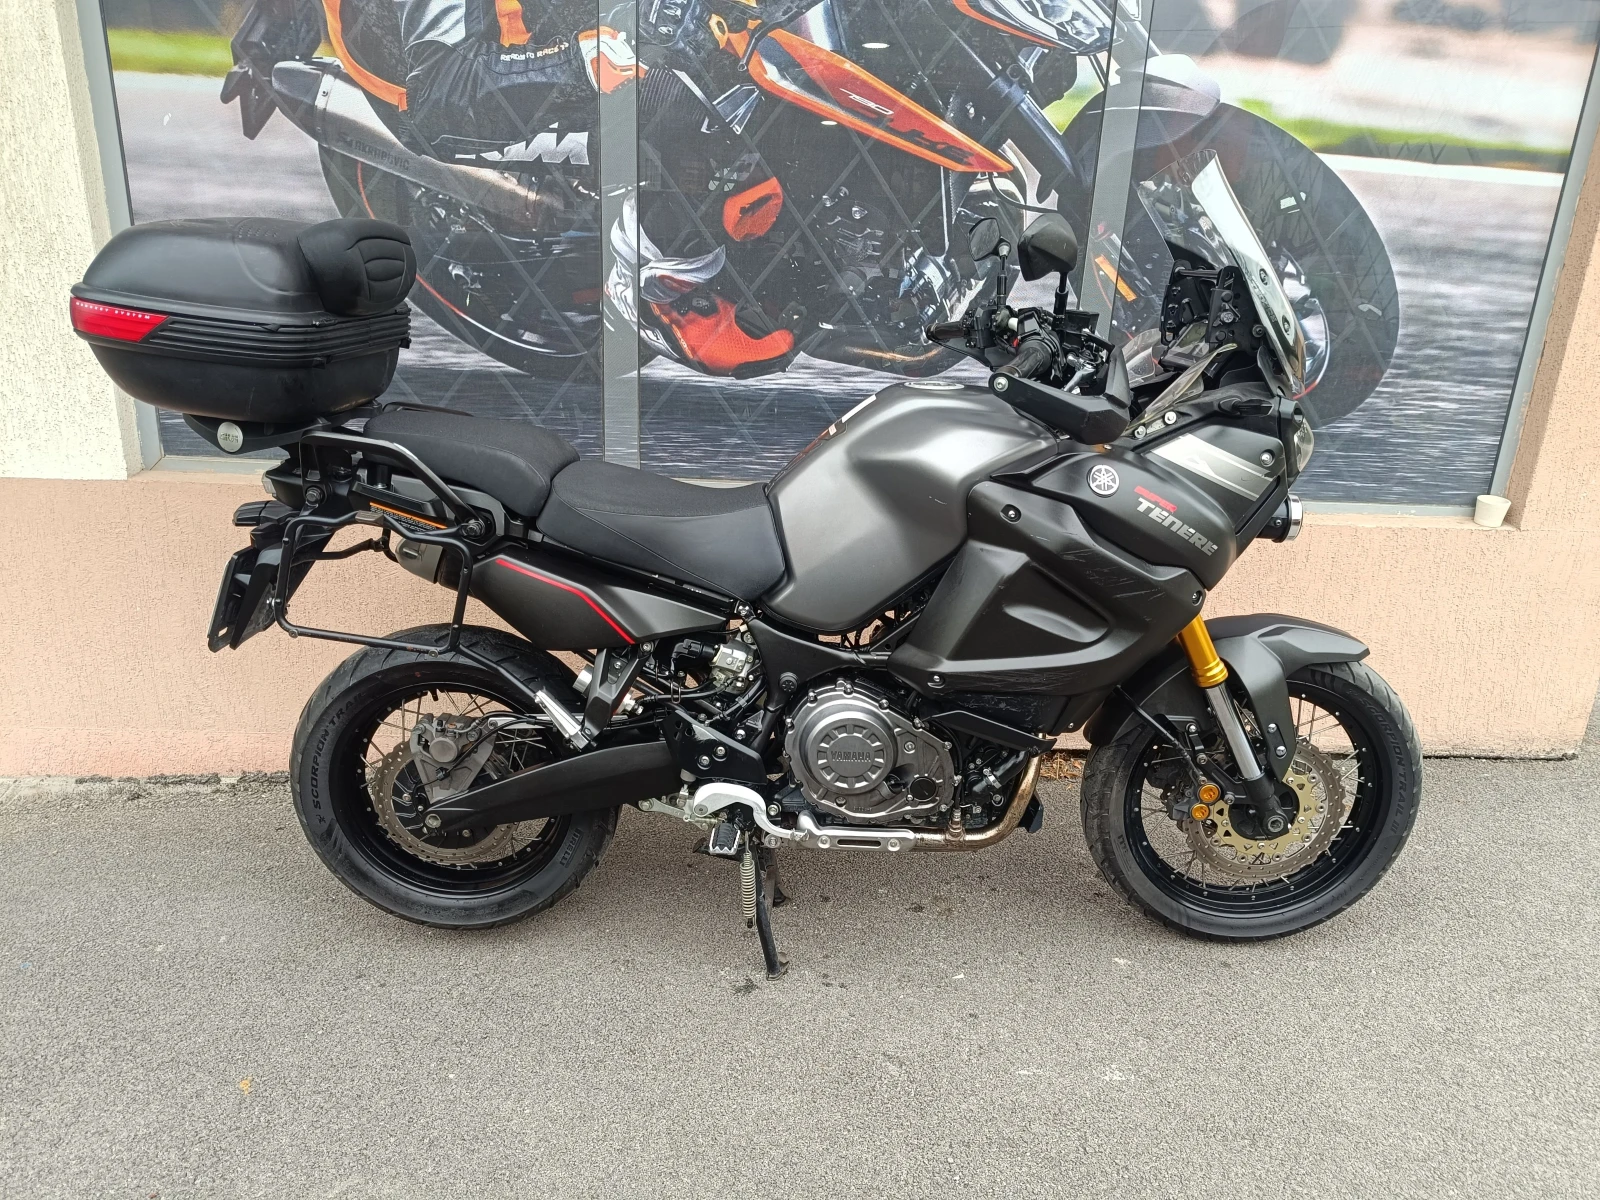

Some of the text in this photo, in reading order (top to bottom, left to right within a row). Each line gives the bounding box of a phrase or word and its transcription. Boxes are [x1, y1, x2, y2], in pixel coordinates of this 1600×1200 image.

[526, 51, 535, 59] TO
[830, 750, 872, 762] YAMAHA
[310, 728, 330, 810] SCORPION
